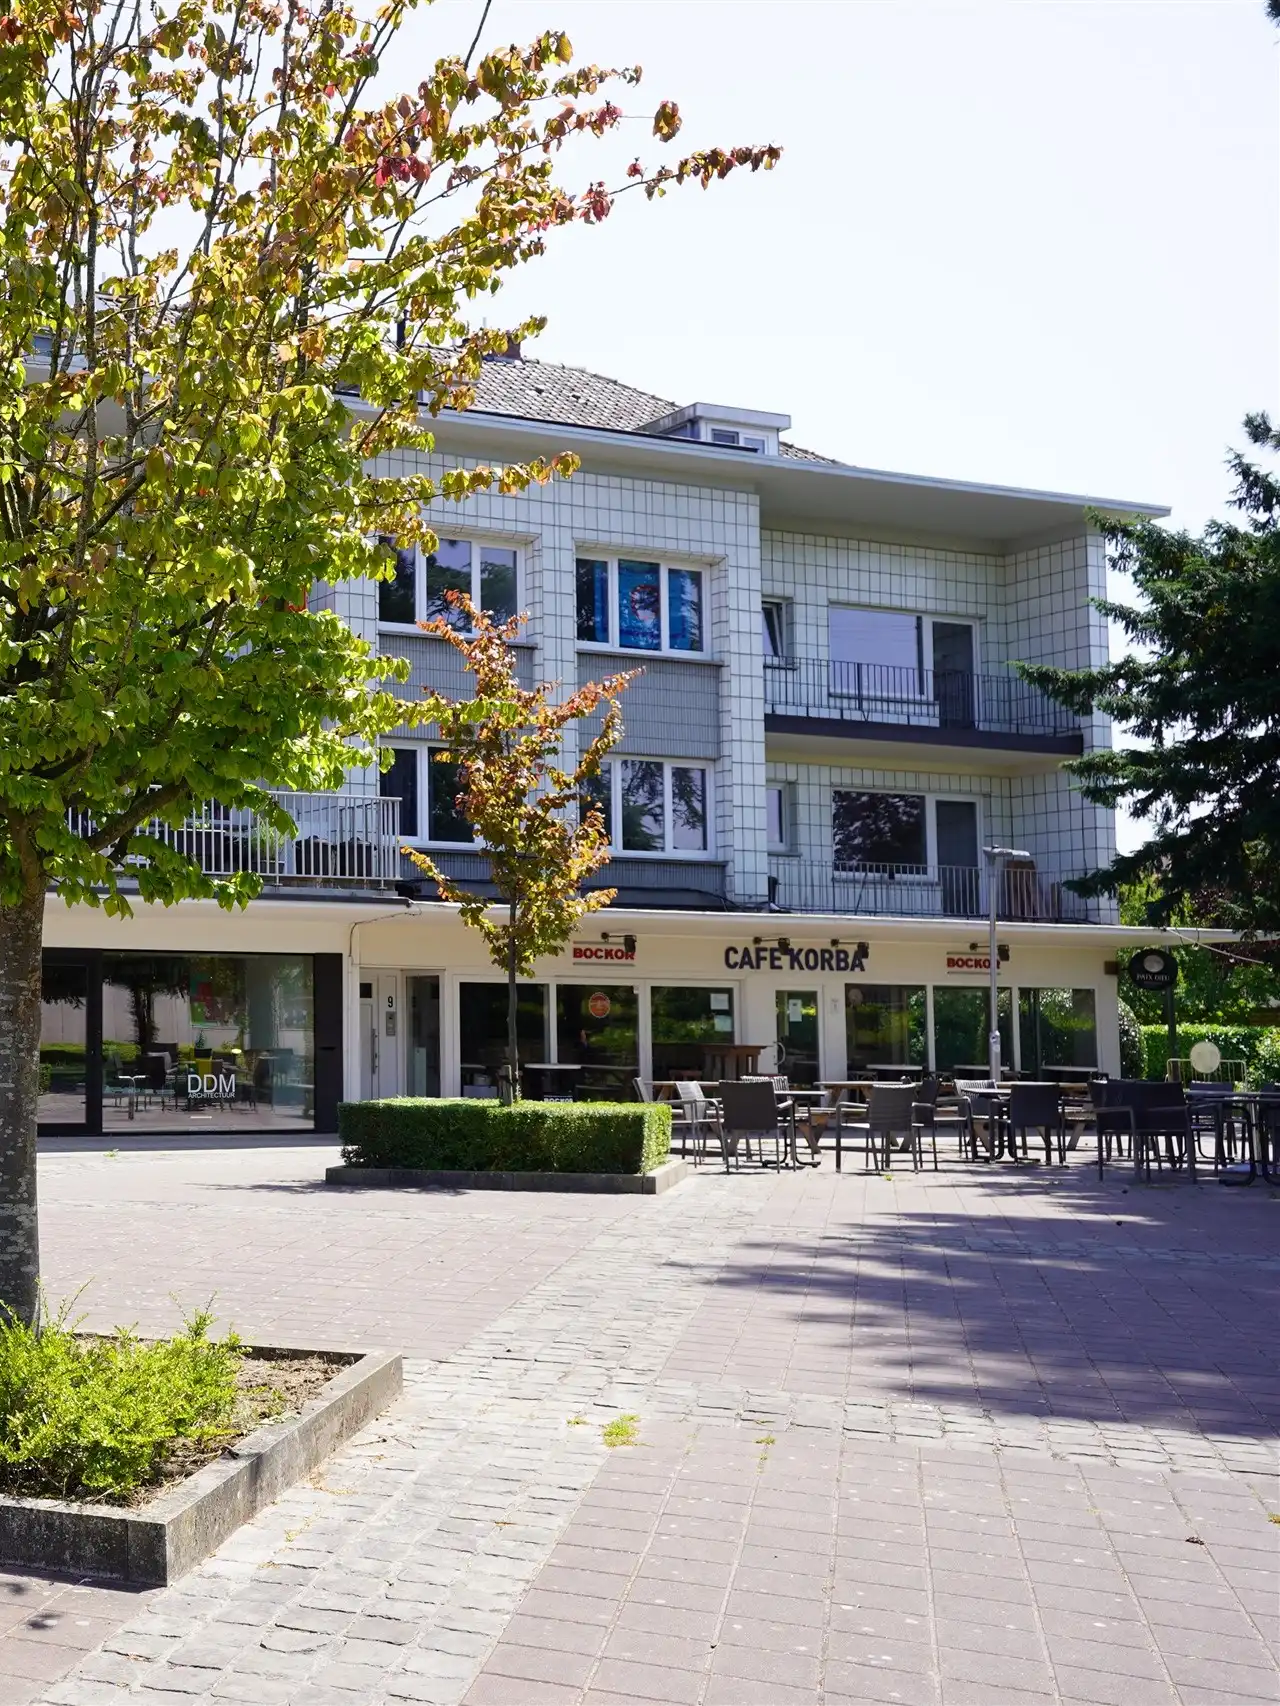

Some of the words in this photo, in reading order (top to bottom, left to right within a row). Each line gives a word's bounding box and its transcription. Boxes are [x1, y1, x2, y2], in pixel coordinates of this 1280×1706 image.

[573, 947, 635, 960] BOCKOR
[724, 946, 783, 970] CAFE
[789, 948, 865, 972] KORBA
[387, 995, 394, 1008] 9
[187, 1074, 236, 1093] DDM
